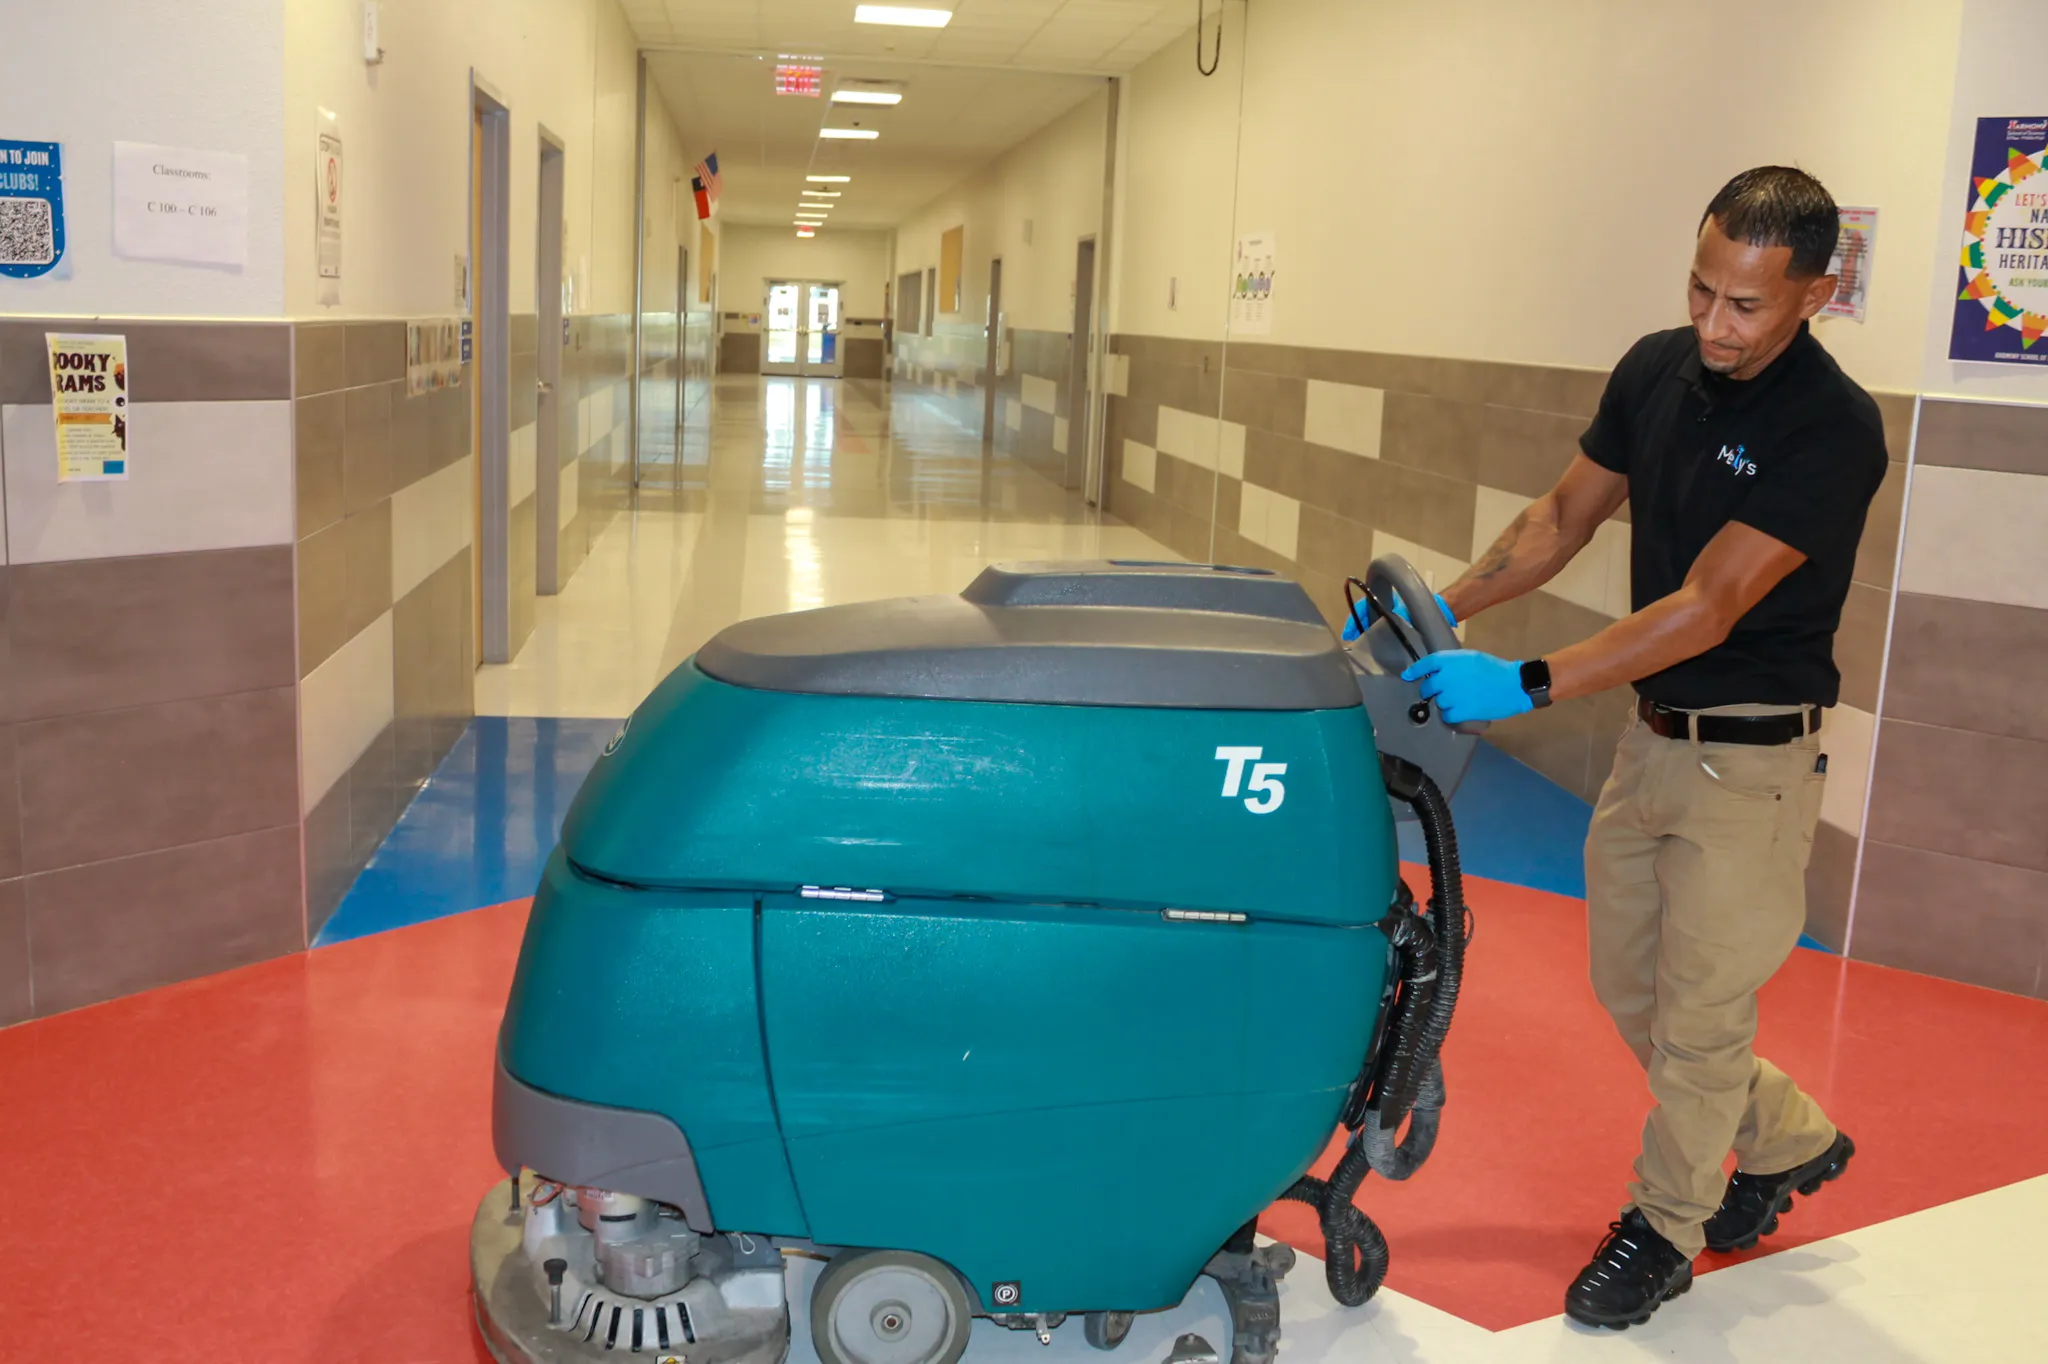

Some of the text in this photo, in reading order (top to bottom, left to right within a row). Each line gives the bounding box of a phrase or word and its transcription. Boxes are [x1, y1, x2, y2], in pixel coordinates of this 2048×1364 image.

[9, 149, 22, 165] TO
[24, 150, 49, 166] JOIN
[2015, 193, 2047, 207] LET'S
[147, 201, 156, 213] C
[160, 202, 177, 214] 100
[188, 205, 198, 216] C
[200, 206, 217, 217] 106
[1995, 226, 2048, 250] HIS
[1214, 746, 1288, 814] T5
